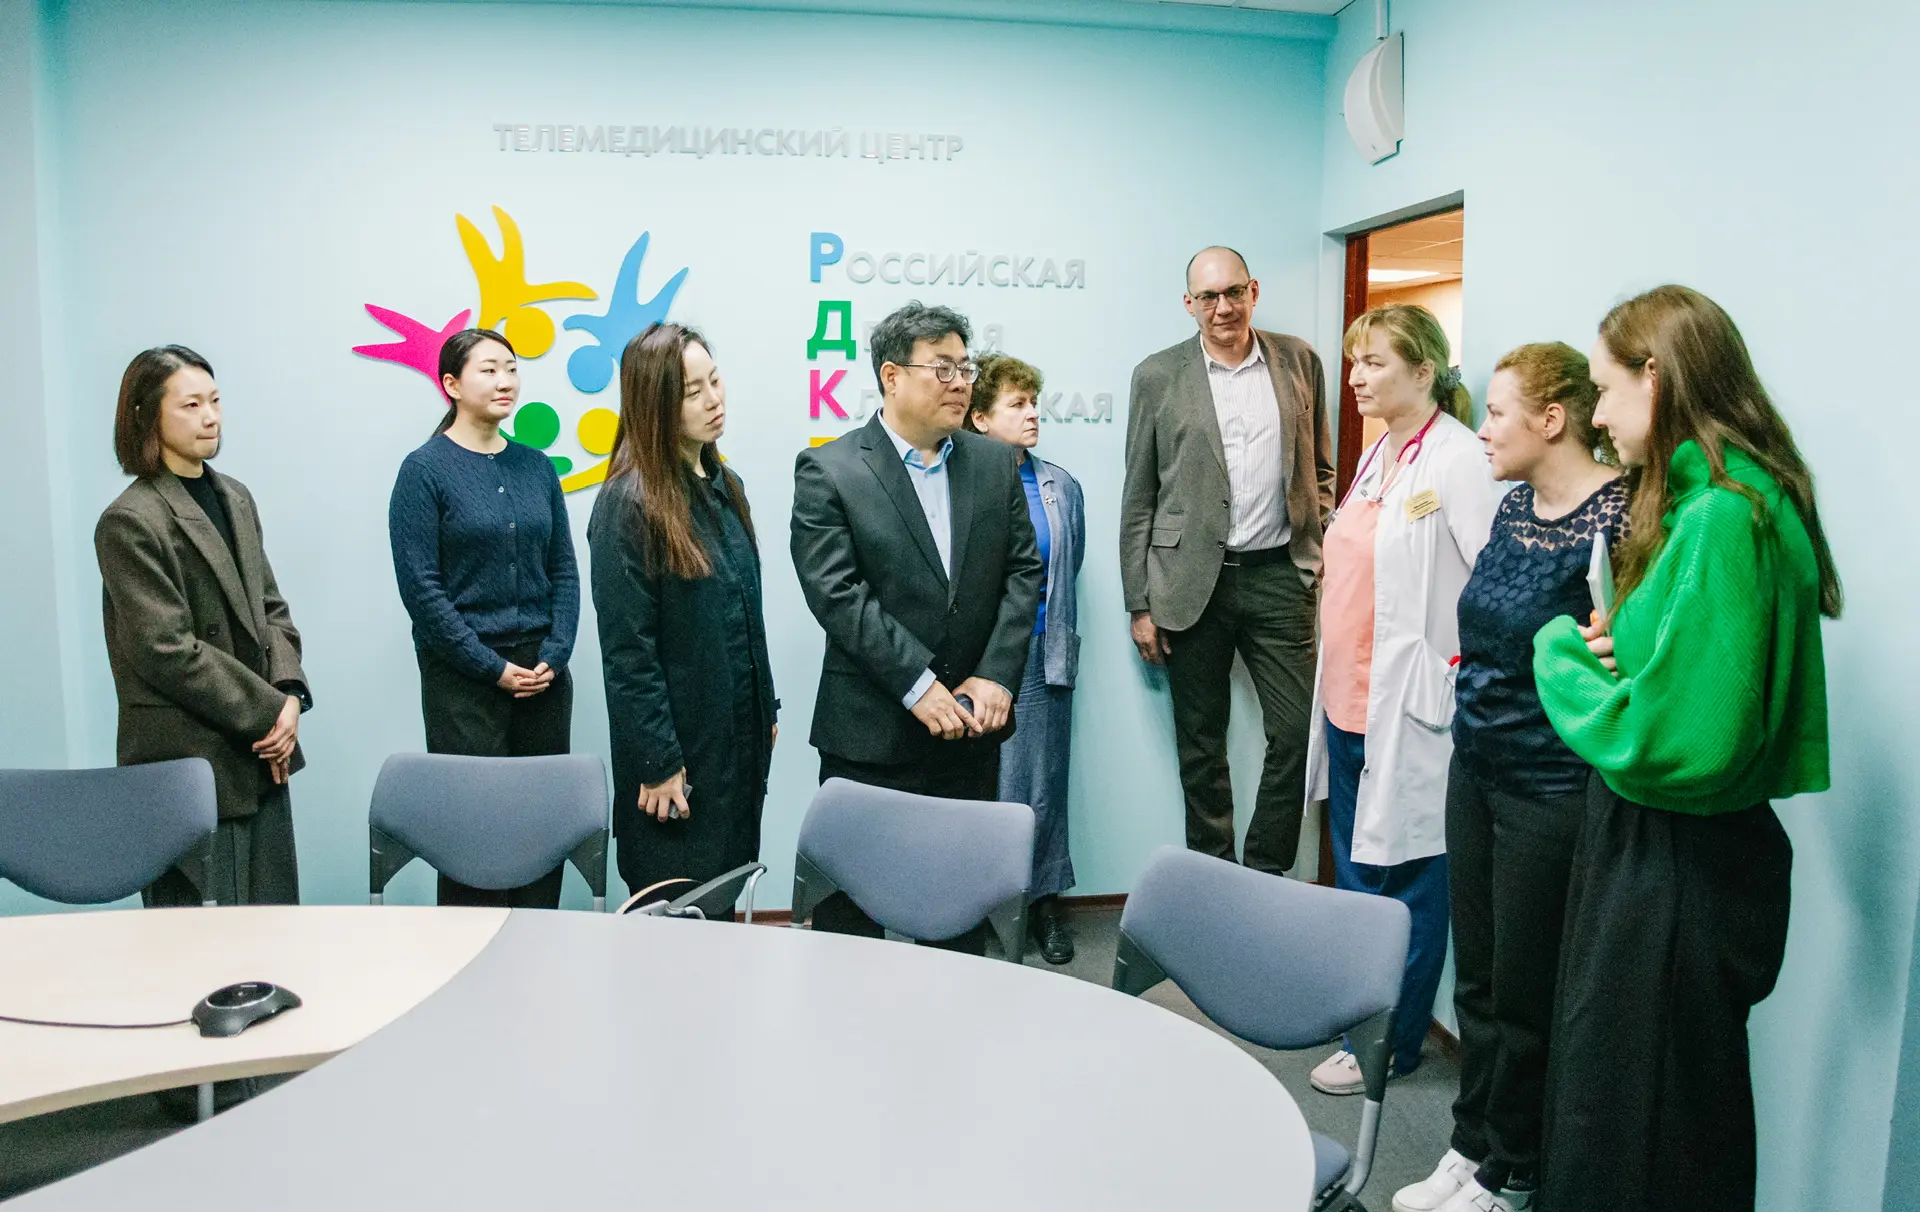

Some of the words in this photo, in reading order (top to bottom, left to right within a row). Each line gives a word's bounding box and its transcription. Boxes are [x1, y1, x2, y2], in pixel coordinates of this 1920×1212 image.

[493, 123, 849, 160] ТЕЛЕМЕДИЦИНСКИЙ
[860, 131, 964, 165] ЦЕНТР
[808, 231, 1086, 289] РОССИЙСКАЯ
